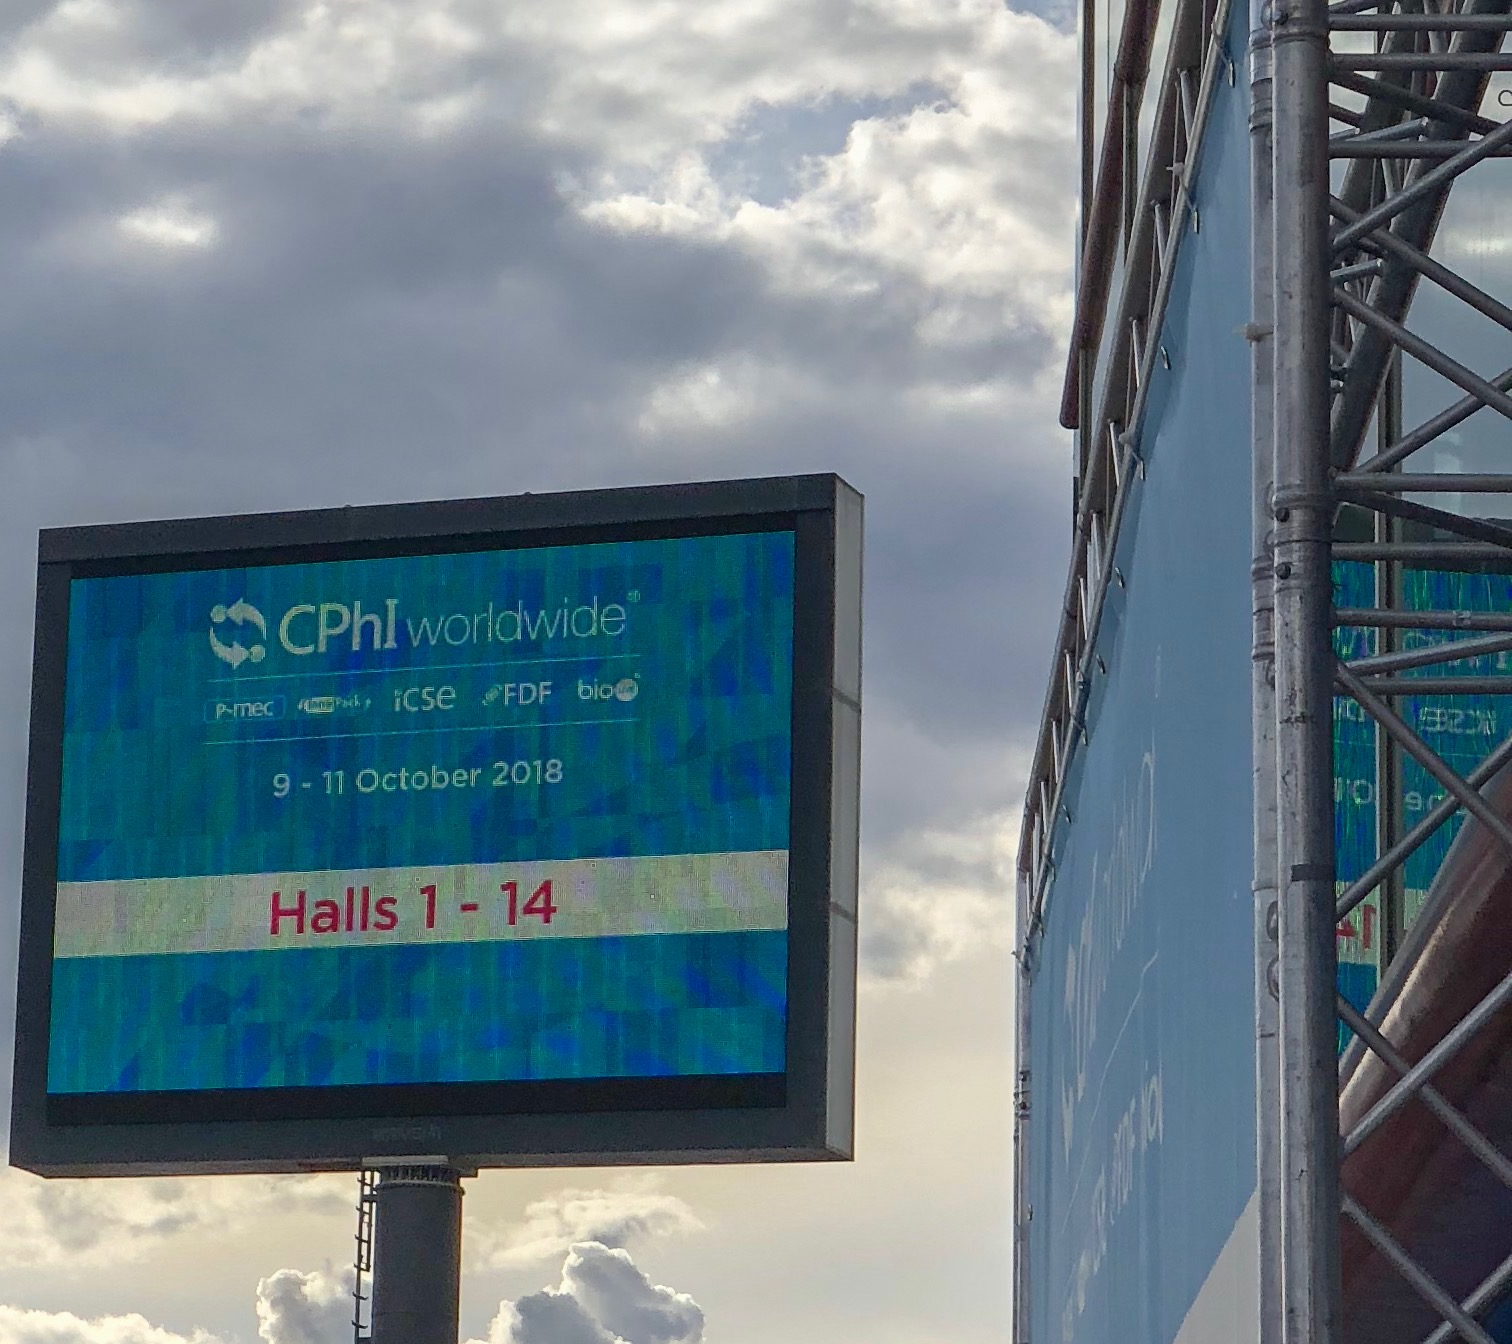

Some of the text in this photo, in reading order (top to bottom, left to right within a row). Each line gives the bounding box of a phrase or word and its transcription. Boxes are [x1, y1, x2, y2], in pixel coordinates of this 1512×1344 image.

[280, 596, 626, 655] CPhI worldwide
[503, 681, 553, 705] FDF
[273, 773, 289, 798] 9
[322, 770, 344, 795] 11
[355, 765, 482, 793] October
[492, 758, 563, 787] 2018
[270, 885, 399, 936] Halls
[419, 883, 437, 929] 1
[499, 879, 558, 926] 14
